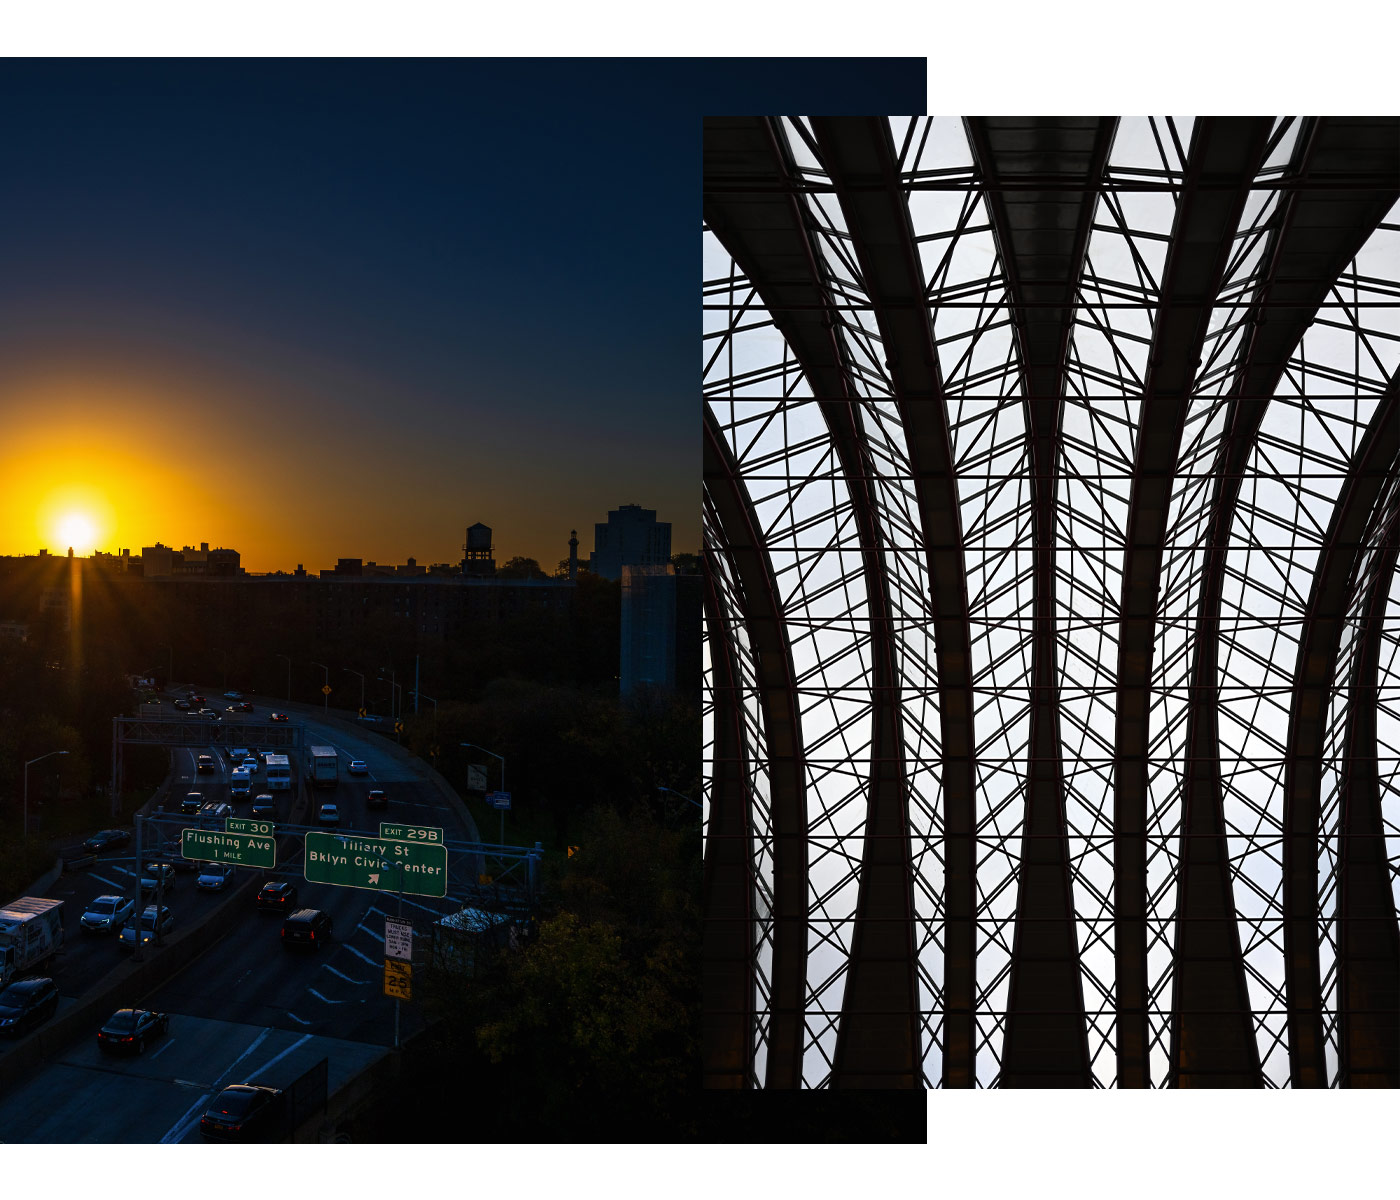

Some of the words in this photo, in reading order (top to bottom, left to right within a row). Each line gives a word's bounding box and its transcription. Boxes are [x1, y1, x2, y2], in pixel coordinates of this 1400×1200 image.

[229, 822, 246, 830] EXIT
[250, 823, 269, 833] 30
[406, 829, 438, 840] 29B
[187, 832, 240, 849] Flushing
[248, 840, 271, 850] Ave
[214, 849, 218, 858] 1
[394, 846, 409, 856] St
[309, 851, 347, 866] Bklyn
[354, 857, 388, 869] Civic
[388, 976, 408, 989] 25
